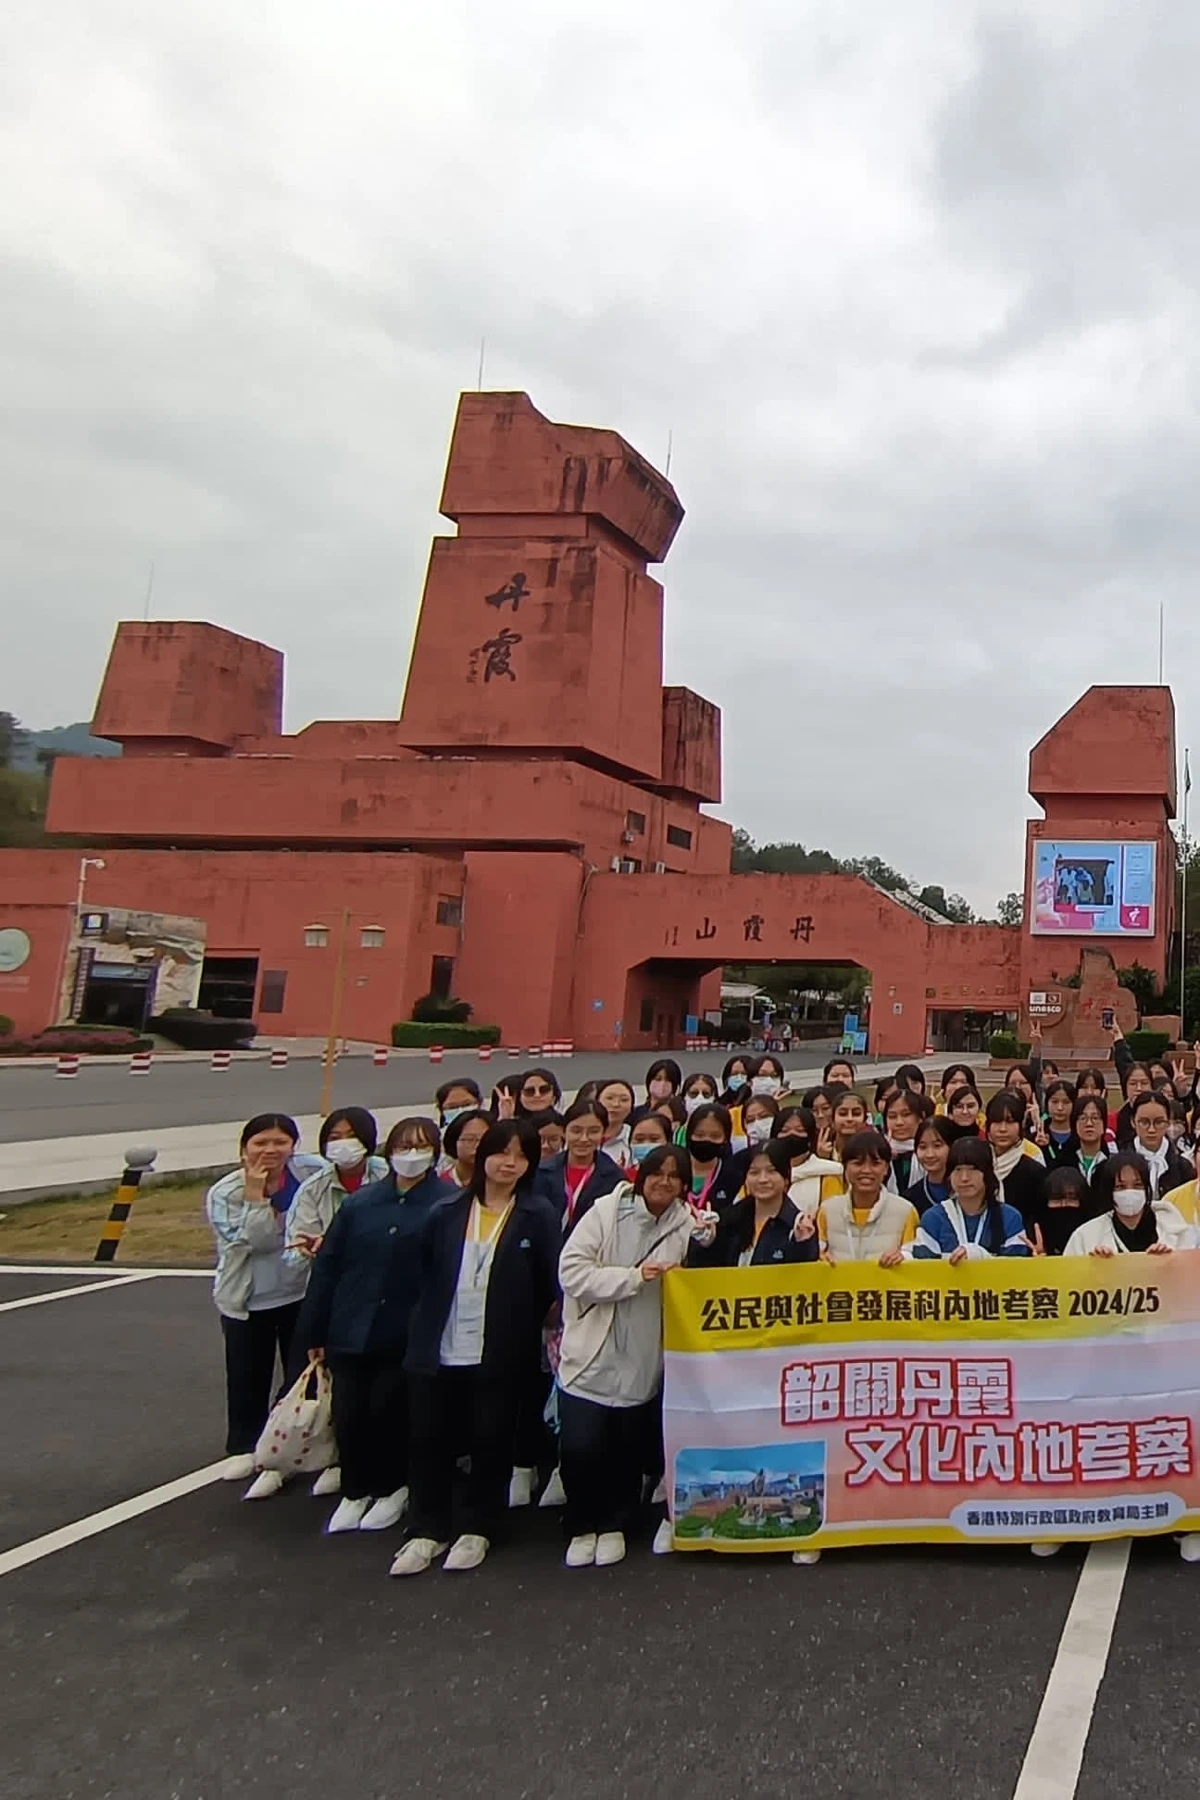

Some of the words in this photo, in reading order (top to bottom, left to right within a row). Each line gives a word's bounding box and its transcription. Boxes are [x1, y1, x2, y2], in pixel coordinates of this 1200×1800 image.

[695, 915, 815, 944] 丹霞山
[1068, 1287, 1160, 1317] 2024/25
[782, 1358, 1013, 1424] 韶關丹霞
